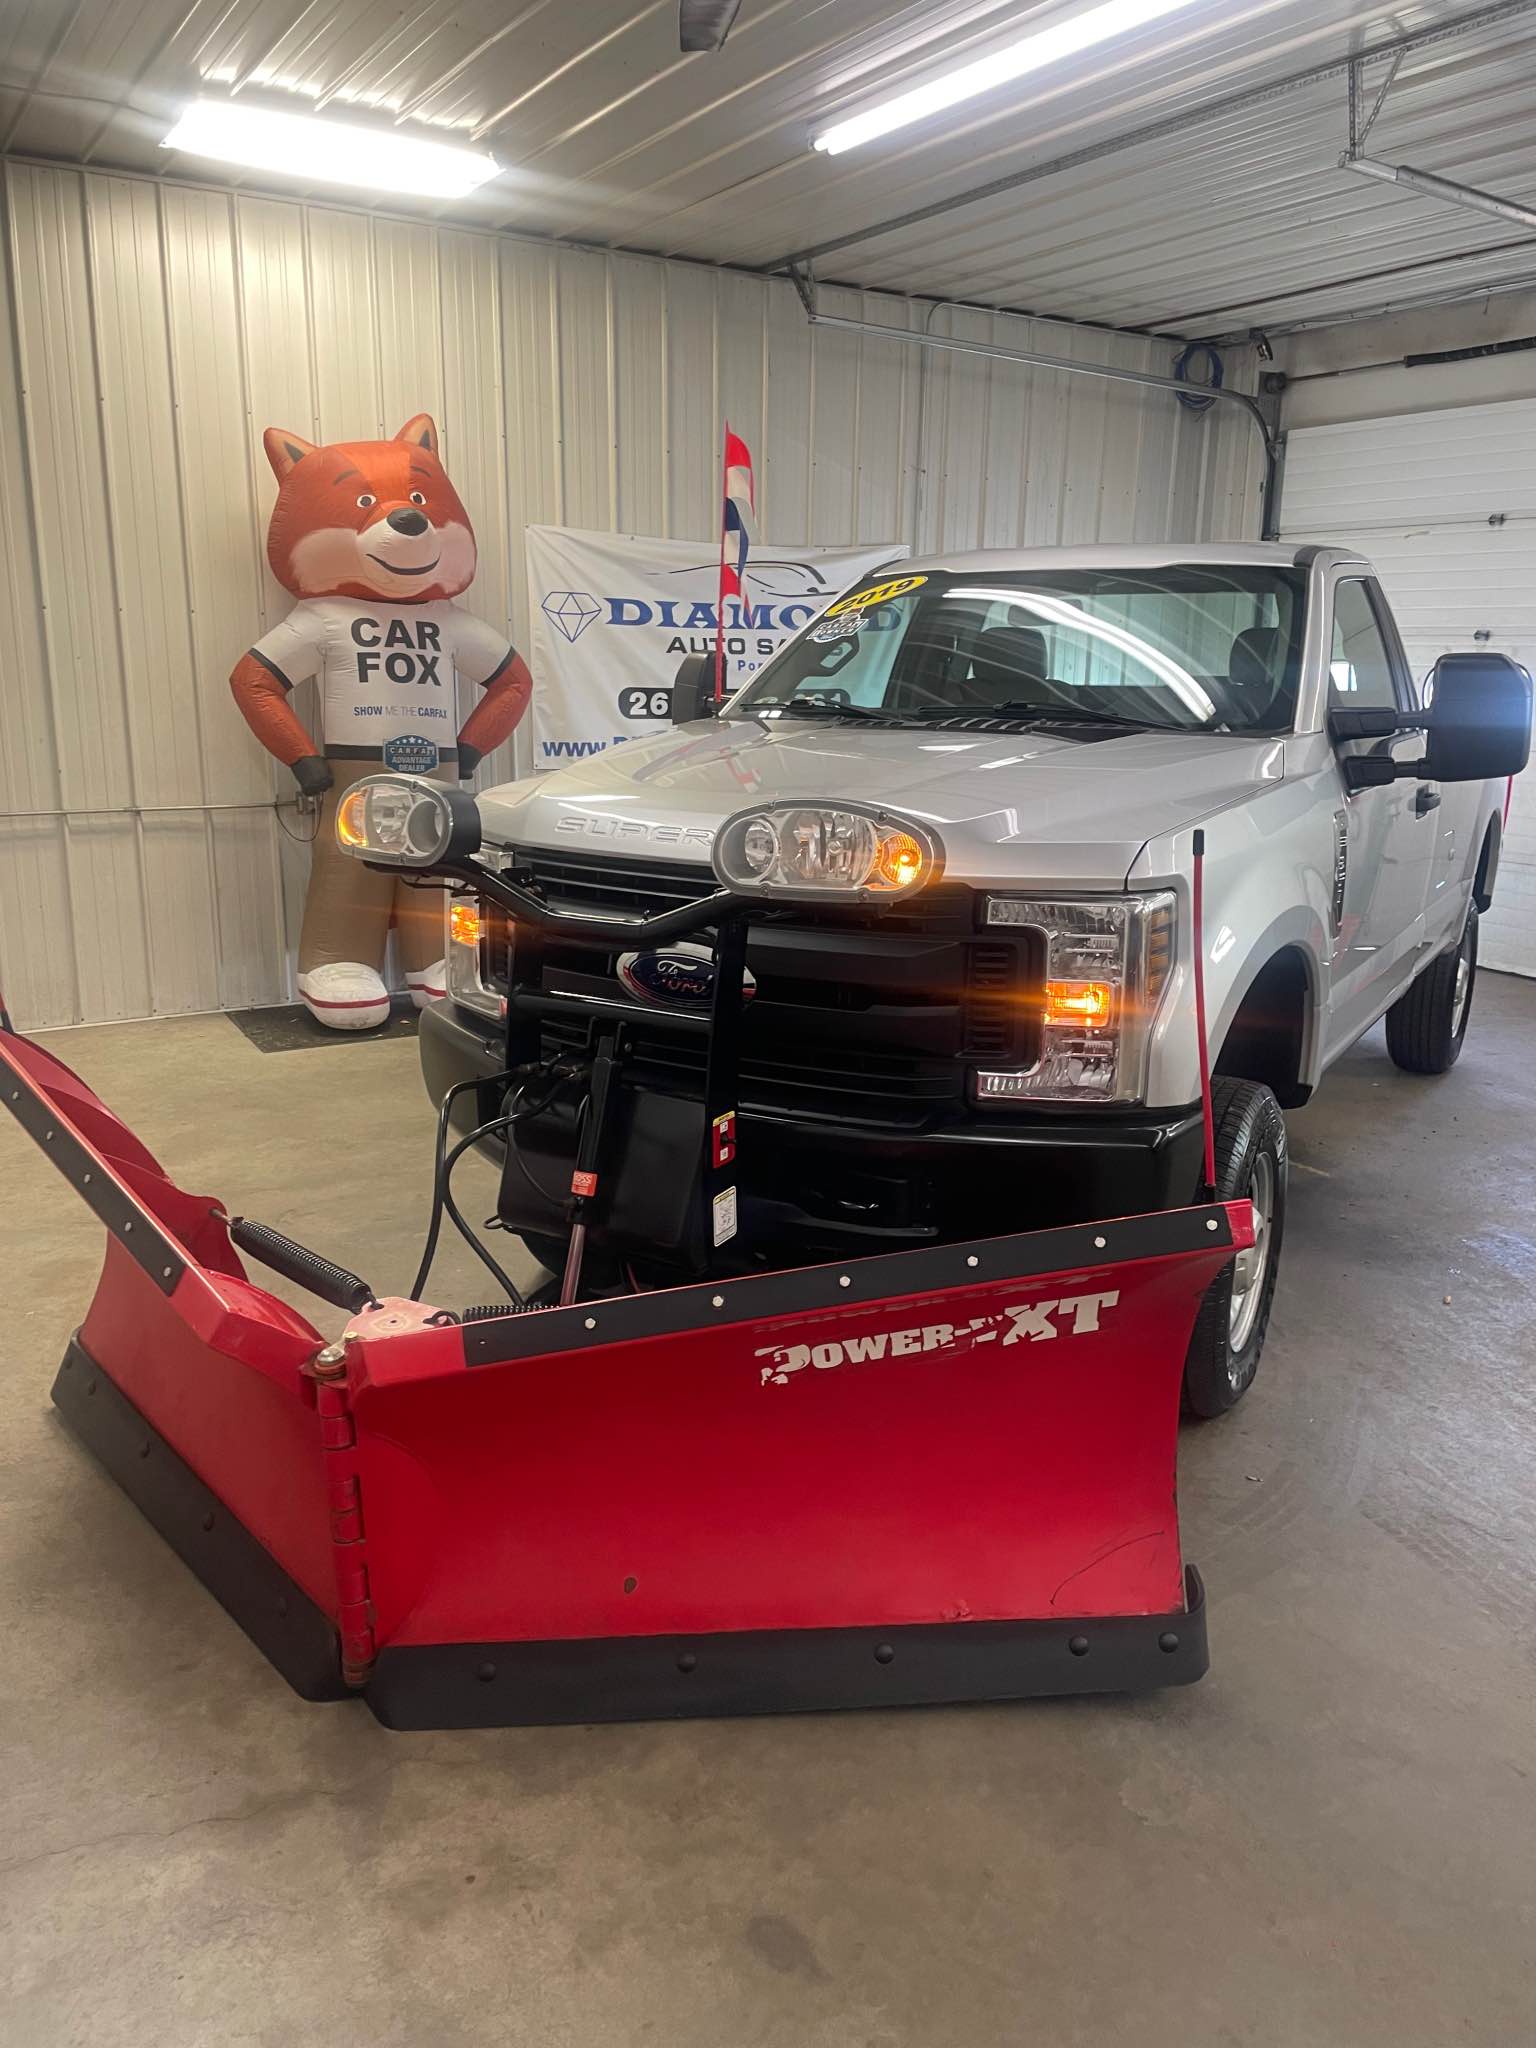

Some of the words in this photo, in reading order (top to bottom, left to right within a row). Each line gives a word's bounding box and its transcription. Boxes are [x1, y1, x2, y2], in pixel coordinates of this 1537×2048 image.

[834, 579, 916, 614] 2019
[603, 597, 902, 633] DIAMOD
[351, 617, 441, 652] CAR
[666, 636, 746, 655] AUTO
[357, 652, 441, 686] FOX
[353, 706, 383, 717] SHOW
[385, 706, 398, 717] ME
[400, 706, 417, 717] THE
[417, 707, 448, 719] CARFAX
[554, 816, 716, 847] SUPER
[648, 960, 714, 996] Ford
